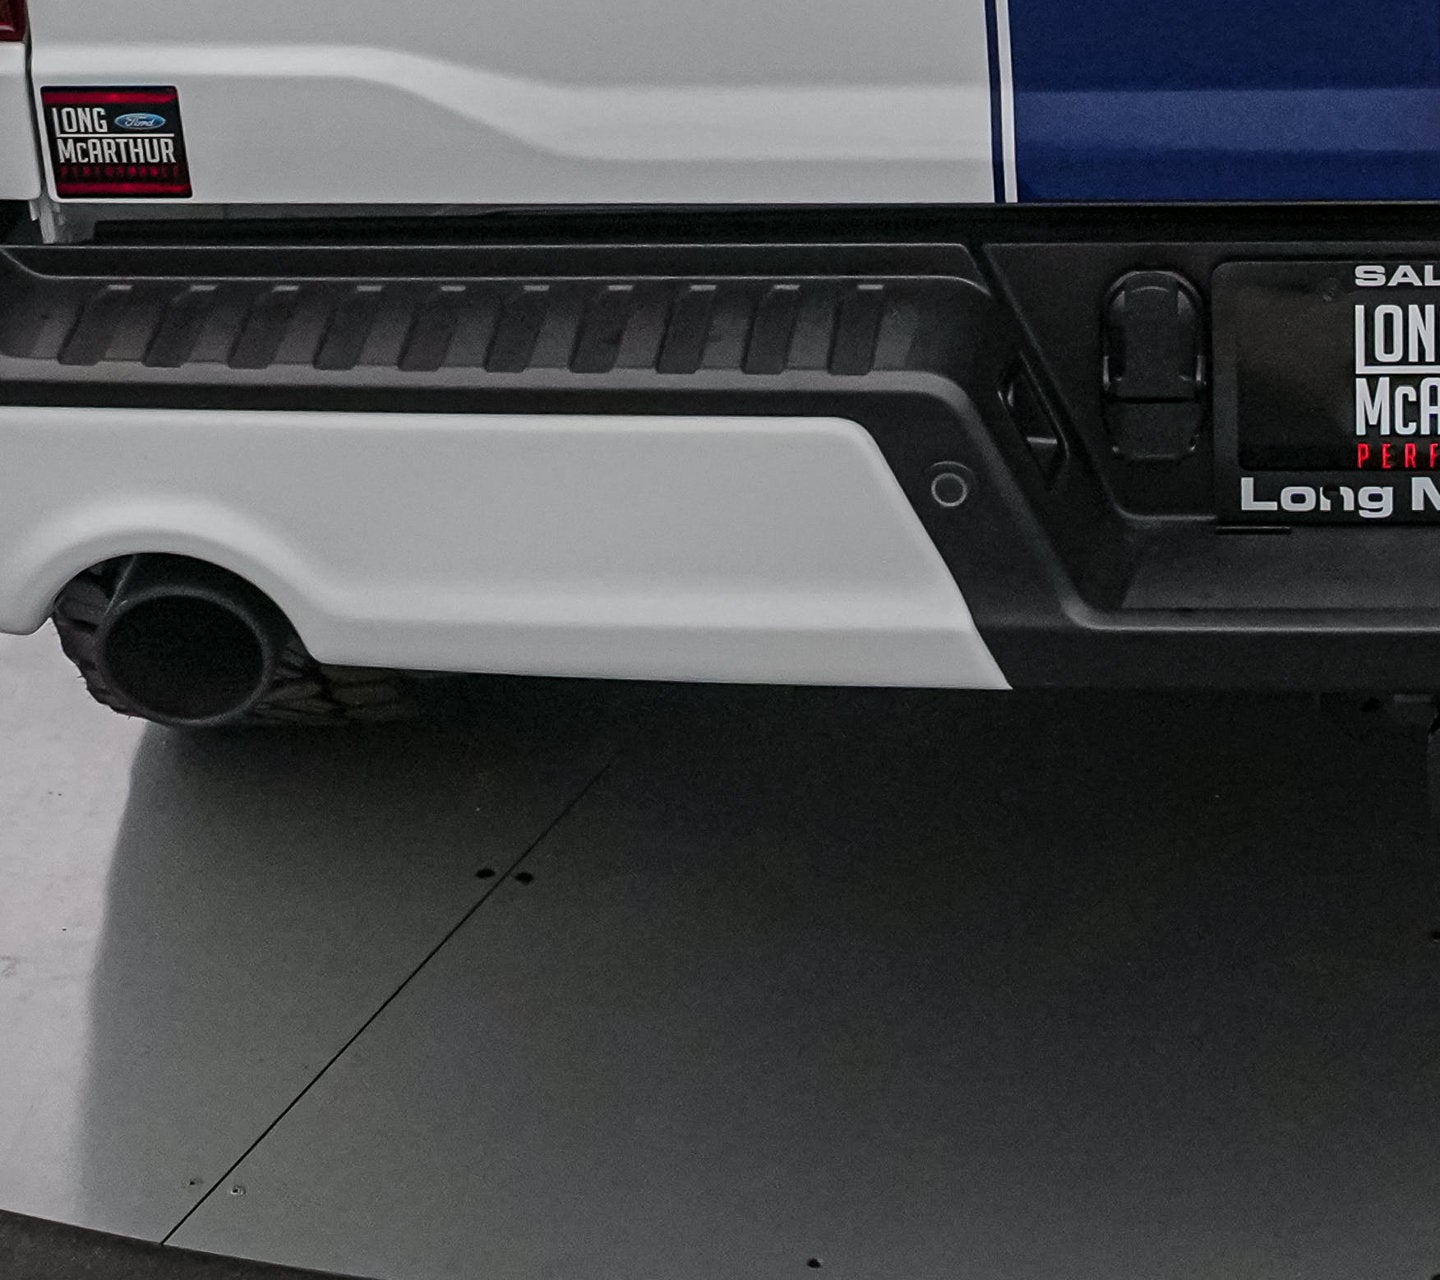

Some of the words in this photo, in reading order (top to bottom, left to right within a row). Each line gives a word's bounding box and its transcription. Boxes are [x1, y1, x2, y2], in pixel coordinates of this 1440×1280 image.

[52, 107, 109, 134] LONG
[57, 138, 177, 164] McARTHUR
[1240, 475, 1395, 519] Long
